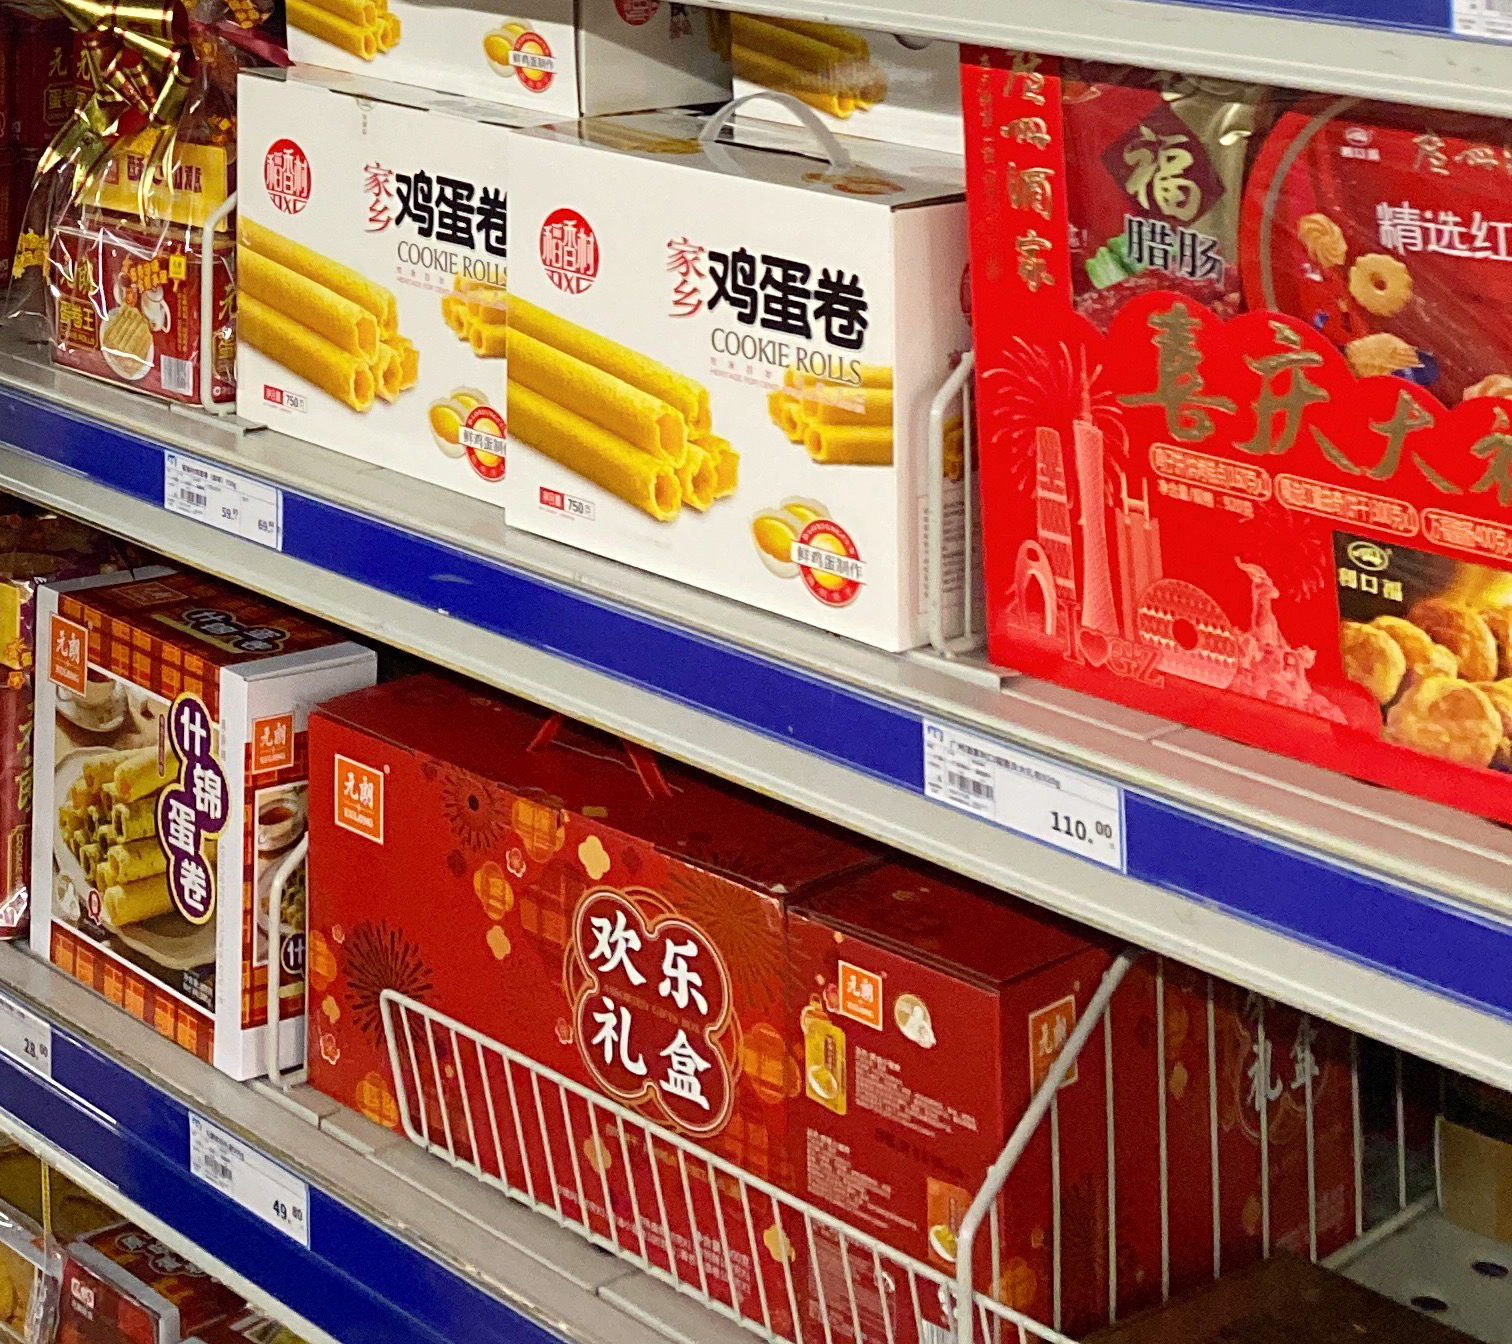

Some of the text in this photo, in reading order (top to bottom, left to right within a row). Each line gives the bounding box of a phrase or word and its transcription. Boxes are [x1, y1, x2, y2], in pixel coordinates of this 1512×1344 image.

[364, 161, 394, 233] 家乡
[1123, 122, 1200, 219] 福
[396, 170, 507, 258] 鸡蛋卷
[542, 220, 595, 274] 稻香村
[1375, 201, 1512, 262] 精选红
[398, 241, 457, 275] COOKIE
[667, 237, 707, 319] 家乡
[1122, 215, 1225, 284] 腊肠
[707, 247, 869, 350] 鸡蛋卷
[711, 328, 863, 386] COOKIE ROLLS
[795, 543, 865, 580] 鲜鸡蛋制作
[56, 630, 80, 664] 元朗
[260, 723, 286, 747] 元朗
[168, 706, 222, 912] 什锦蛋卷
[344, 772, 374, 810] 元朗
[588, 910, 709, 1015] 欢乐
[591, 997, 711, 1111] 礼盒
